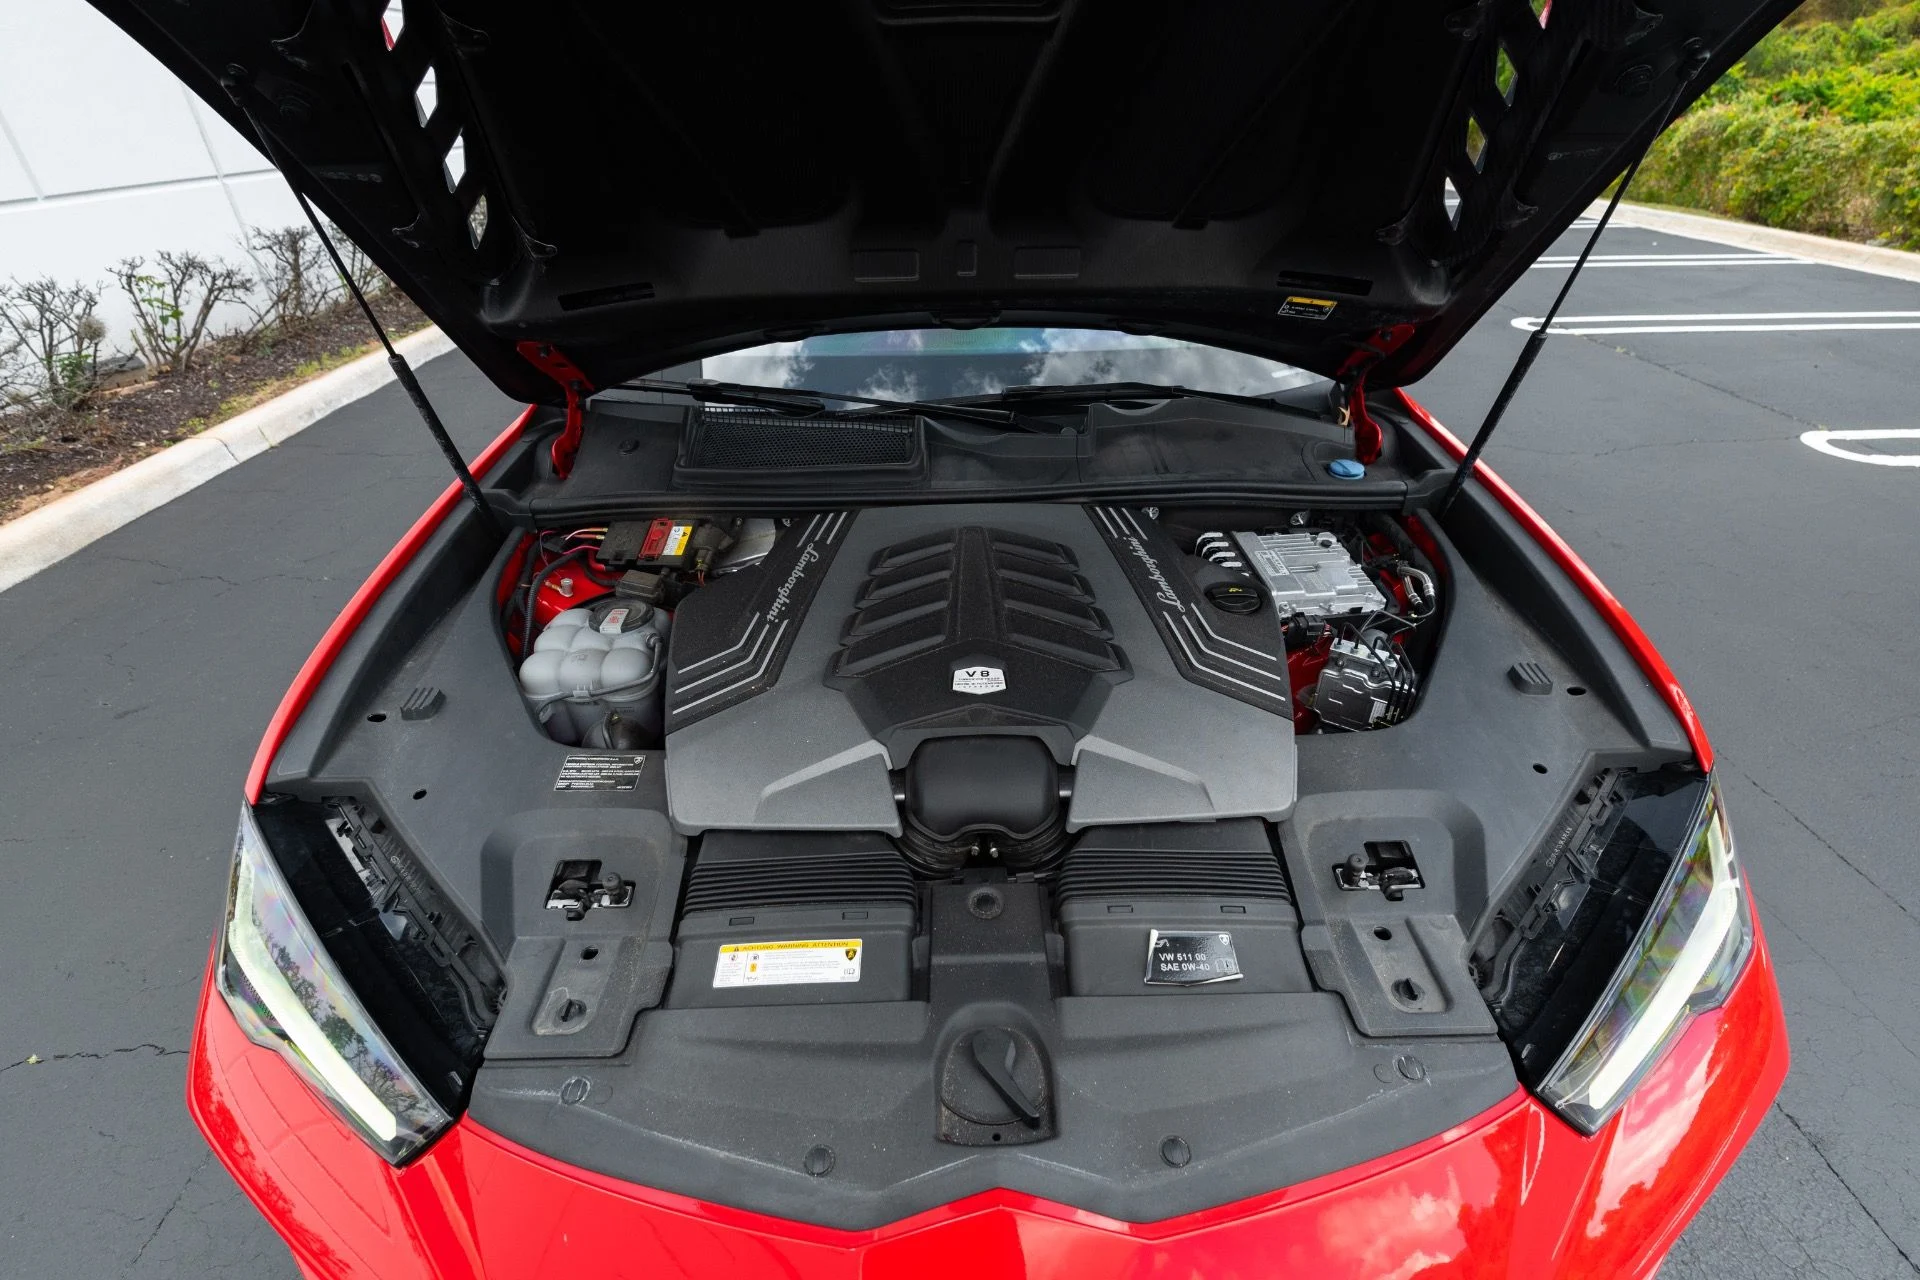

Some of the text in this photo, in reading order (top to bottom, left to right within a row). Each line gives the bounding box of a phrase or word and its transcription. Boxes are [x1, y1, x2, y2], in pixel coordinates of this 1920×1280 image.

[766, 542, 819, 623] Lamborghini
[1123, 536, 1186, 613] Lamborghini
[1159, 953, 1206, 961] VW 511 00
[1160, 963, 1210, 971] SAE 0W-40
